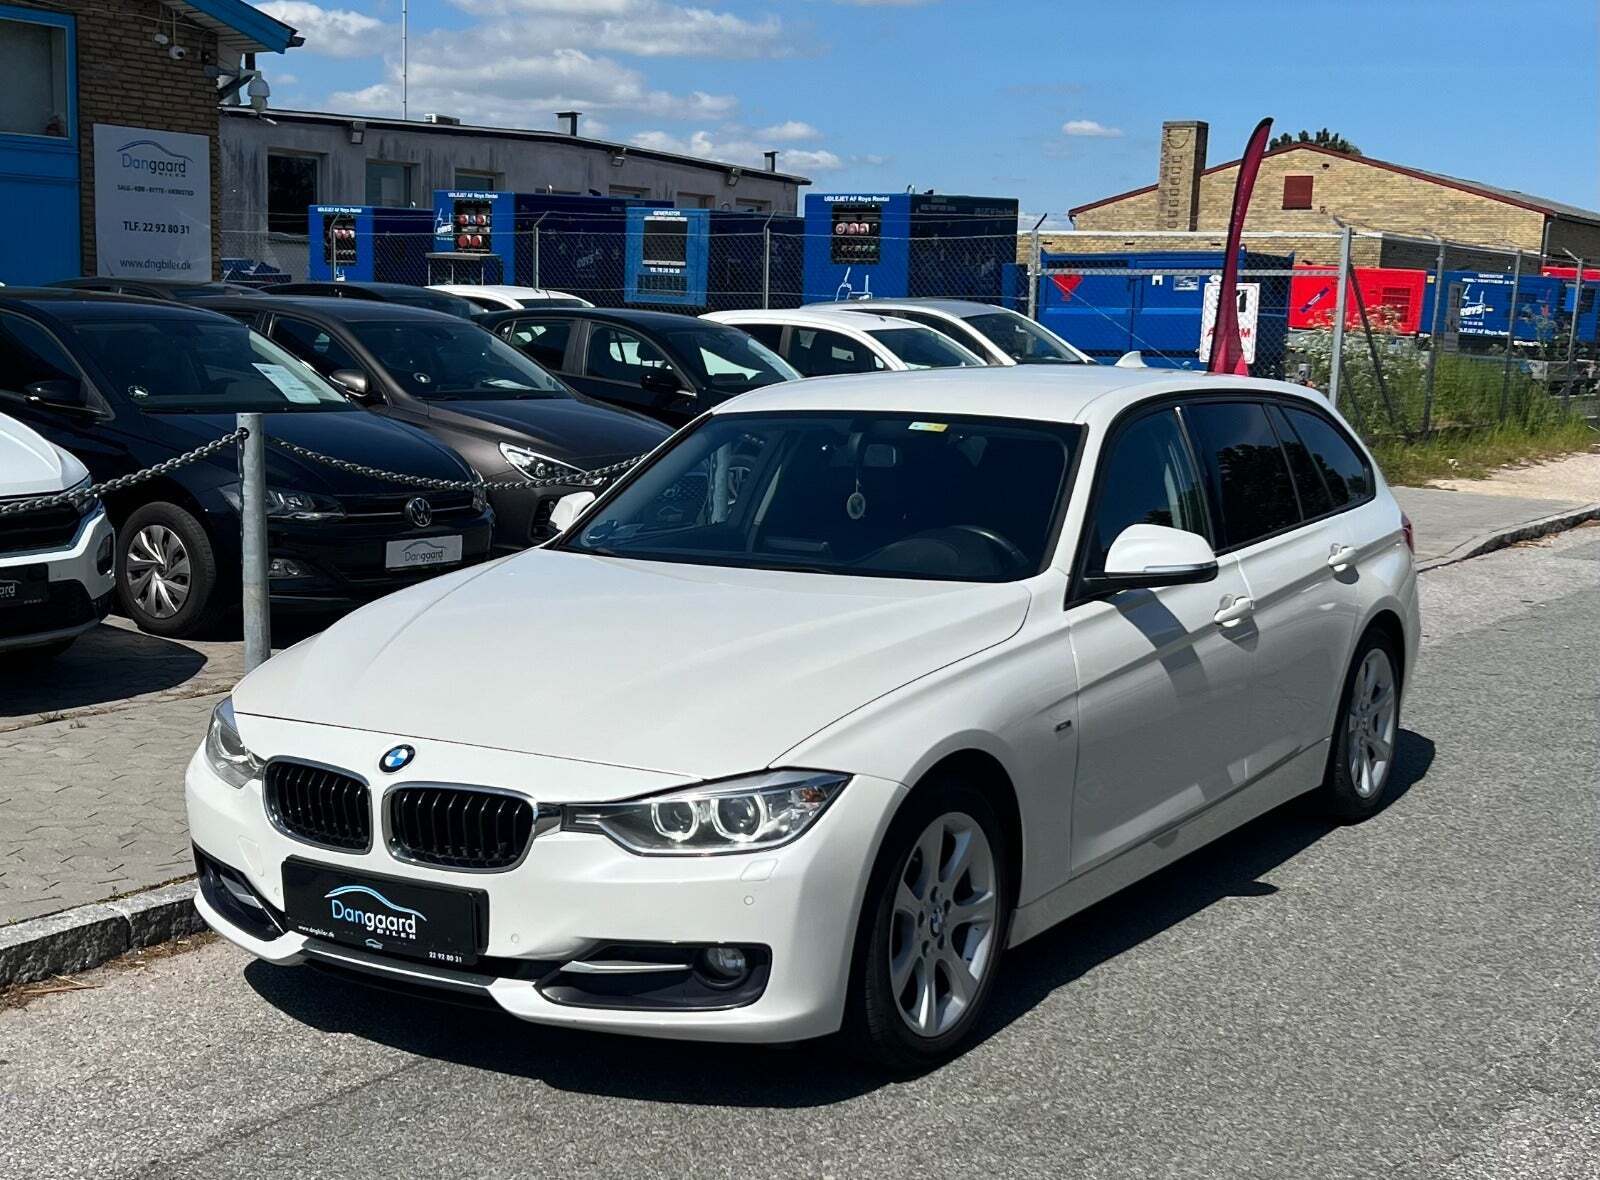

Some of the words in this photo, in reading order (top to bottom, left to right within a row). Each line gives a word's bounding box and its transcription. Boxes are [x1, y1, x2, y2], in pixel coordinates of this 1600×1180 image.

[122, 153, 186, 174] Dangaard
[123, 221, 141, 231] TLF.
[143, 223, 153, 232] 22
[155, 224, 166, 233] 92
[168, 225, 178, 234] 80
[180, 225, 190, 234] 31
[120, 259, 192, 272] www.dngbiler.dk
[331, 900, 416, 933] Dangaard
[377, 929, 416, 940] BILER
[429, 951, 437, 959] 22
